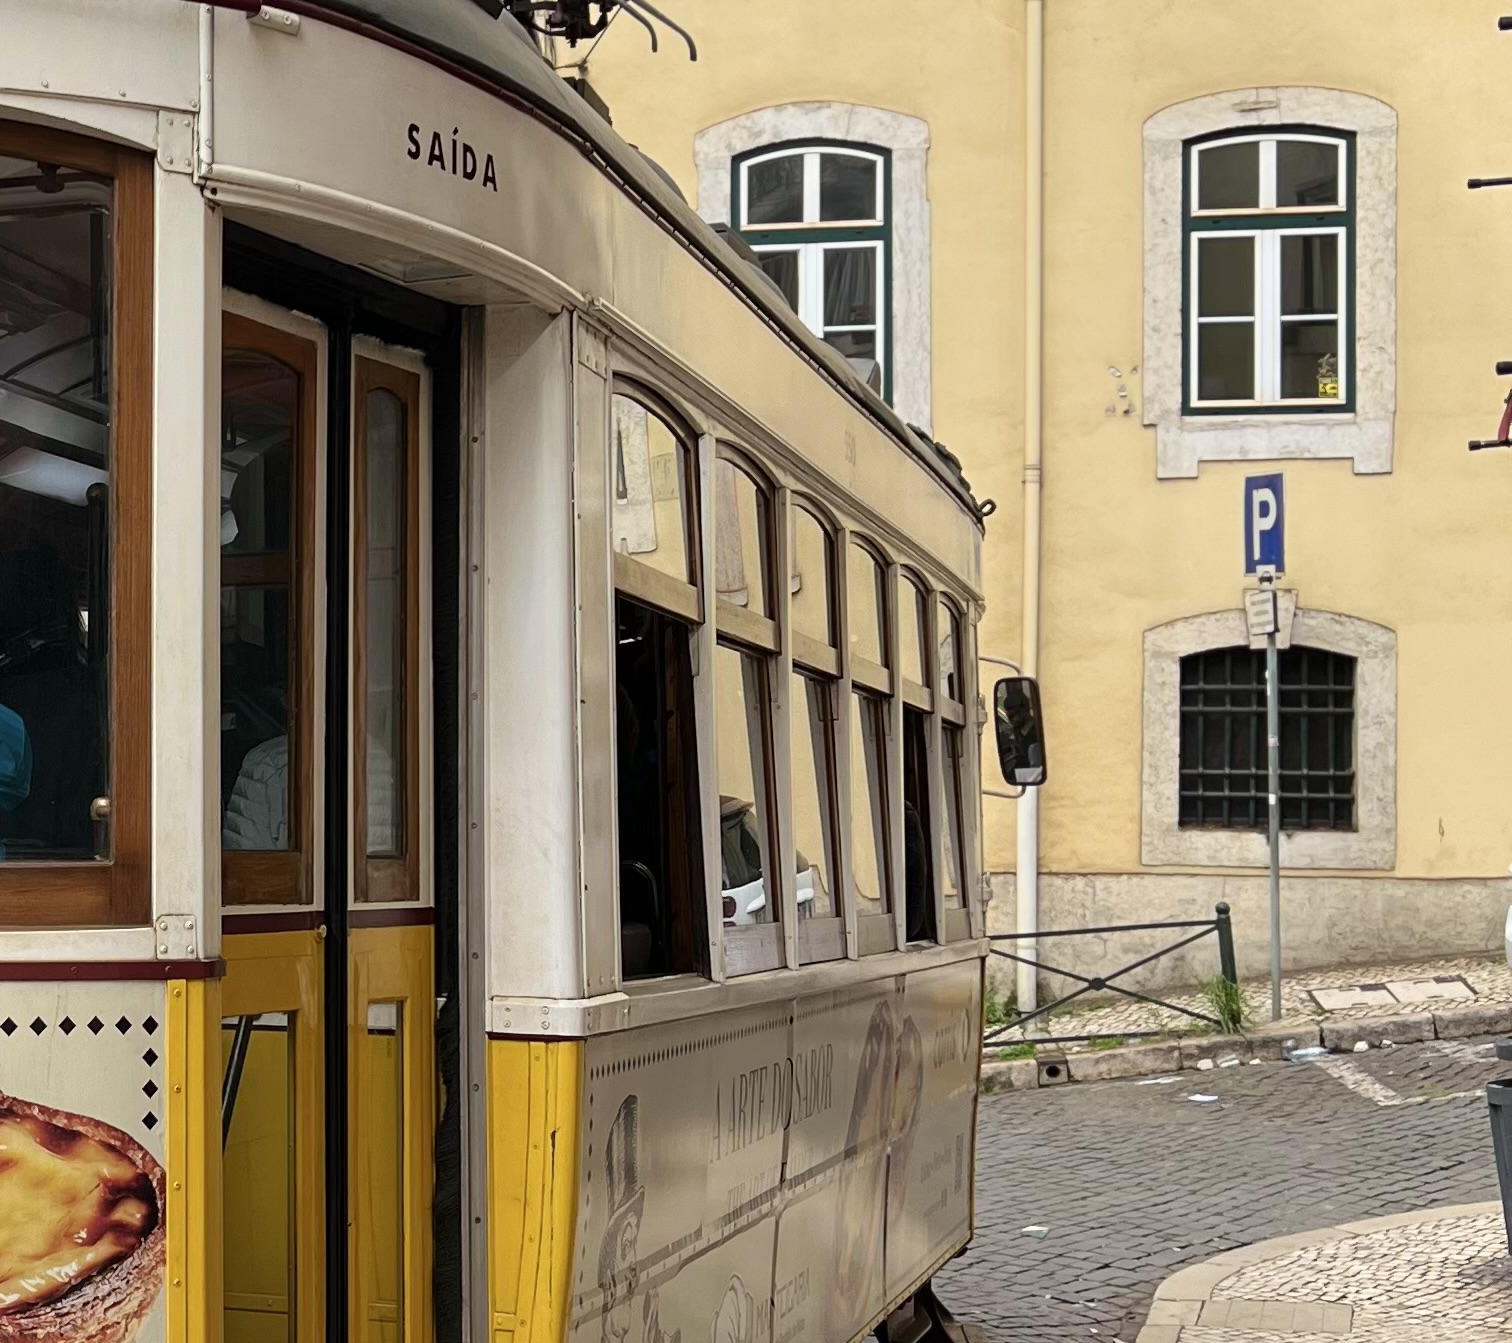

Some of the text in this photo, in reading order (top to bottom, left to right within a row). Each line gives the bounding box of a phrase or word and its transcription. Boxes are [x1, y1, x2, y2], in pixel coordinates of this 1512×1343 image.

[407, 122, 498, 192] SAÍDA
[1252, 487, 1277, 561] P
[725, 1065, 769, 1158] ARTE
[770, 1057, 794, 1136] DO
[793, 1043, 834, 1126] SABOR
